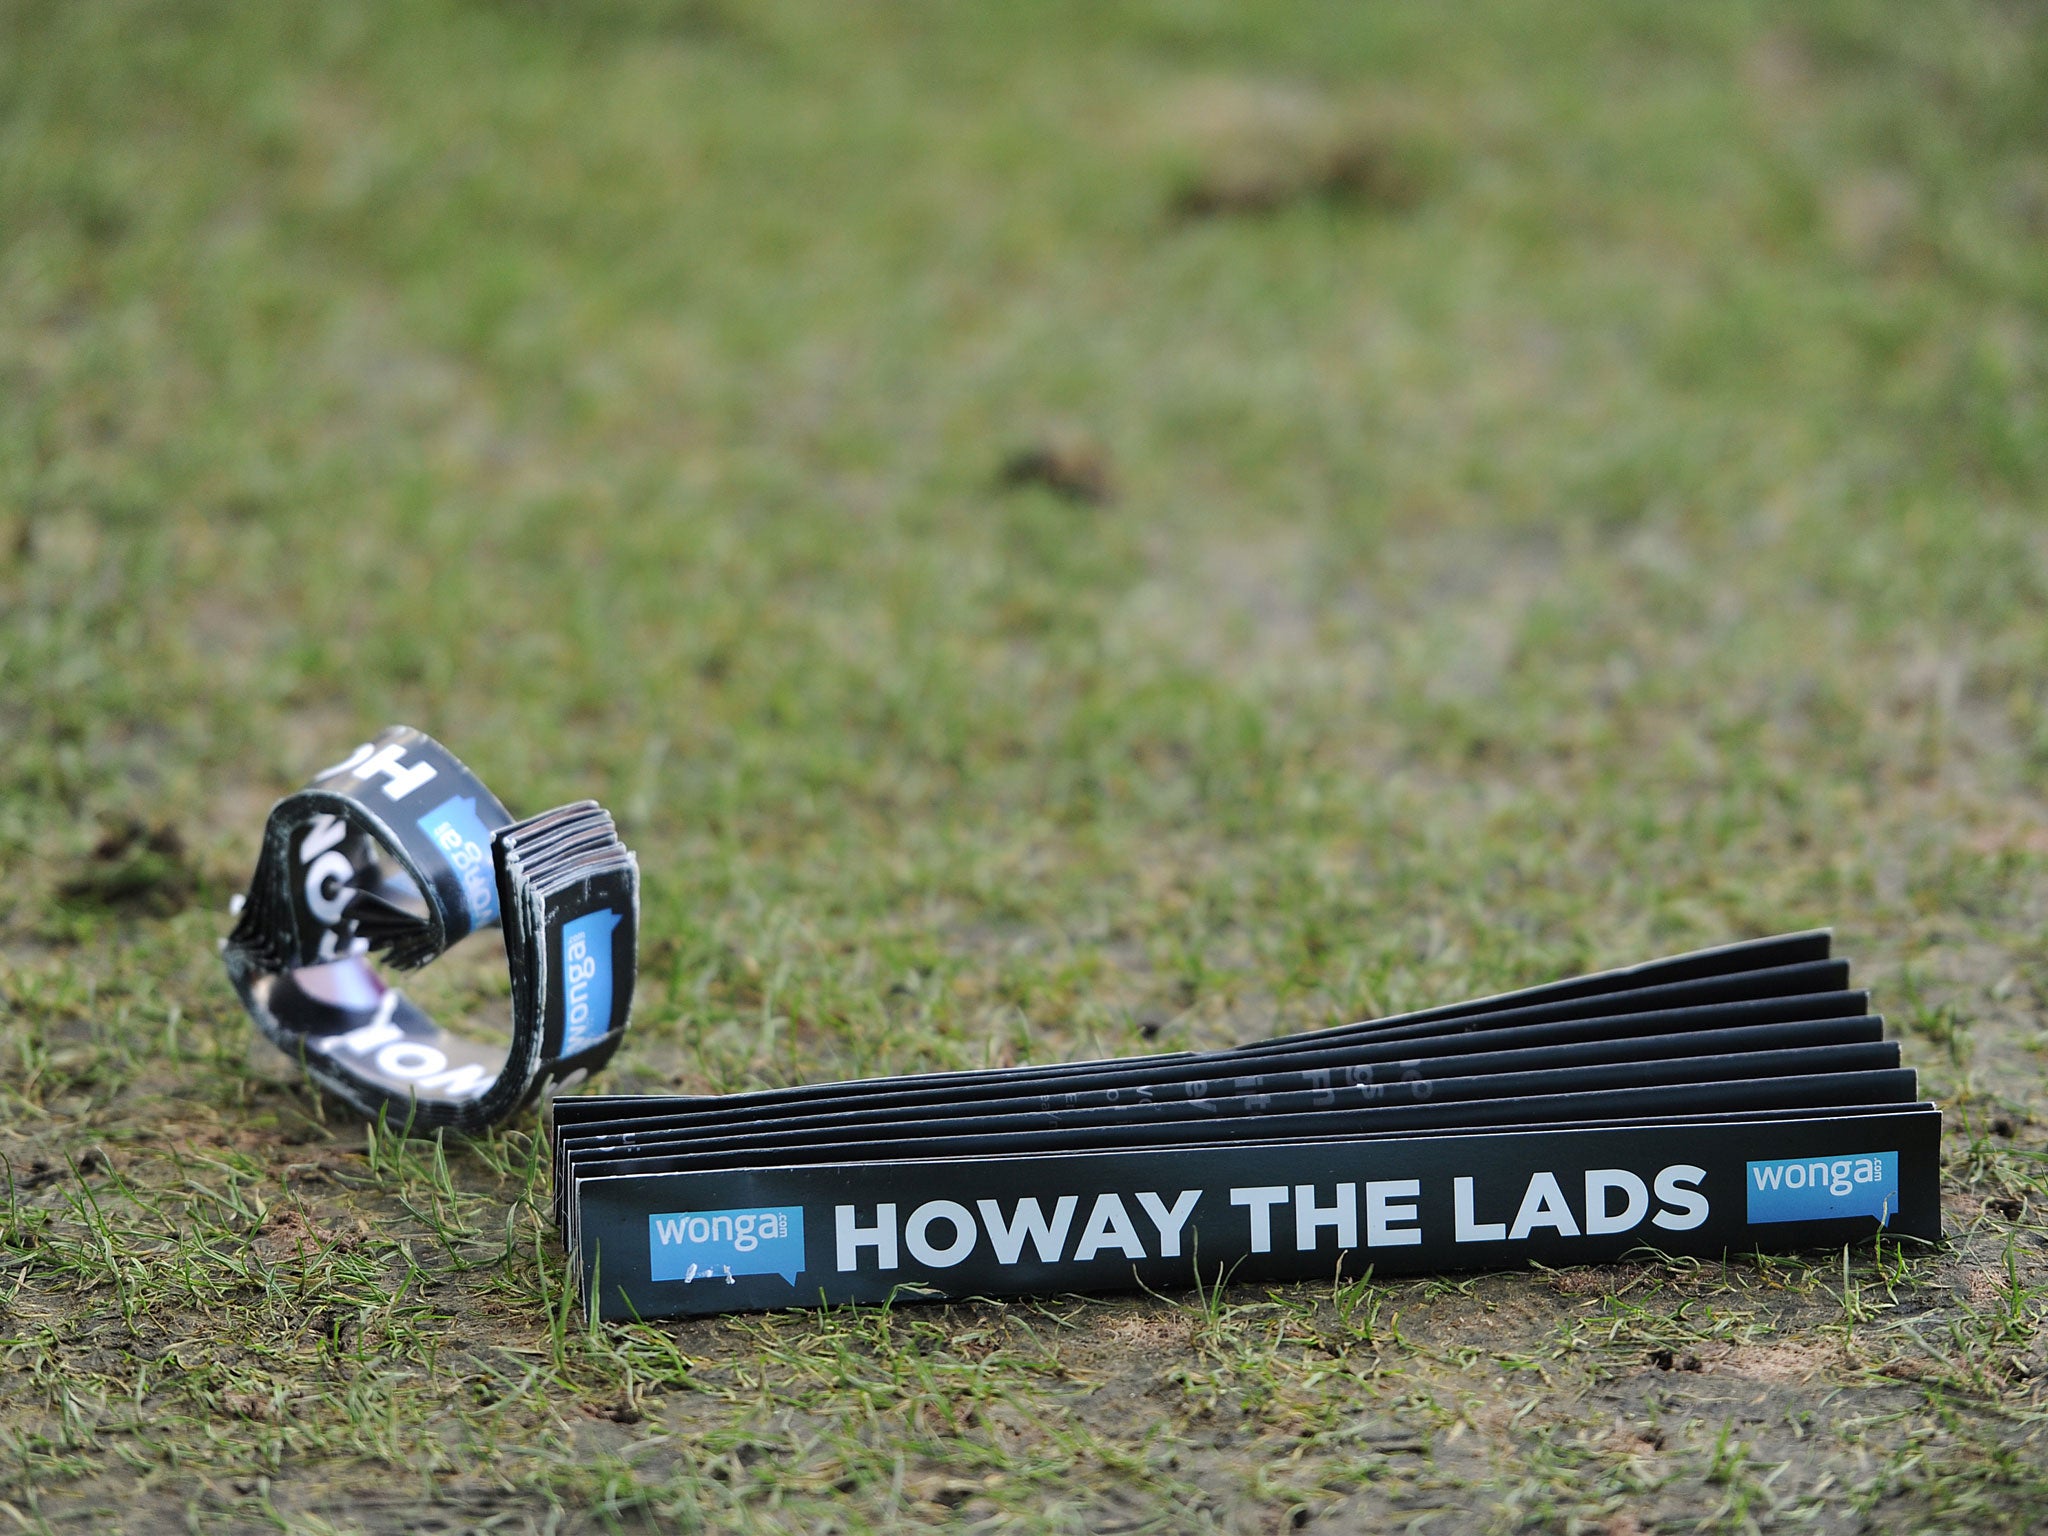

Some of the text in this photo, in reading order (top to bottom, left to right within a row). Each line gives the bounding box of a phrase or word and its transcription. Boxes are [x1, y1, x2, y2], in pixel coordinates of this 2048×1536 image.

[567, 942, 596, 1053] wonga
[1752, 1158, 1873, 1196] wonga
[655, 1212, 778, 1252] wonga
[834, 1164, 1710, 1272] HOWAY THE LADS
